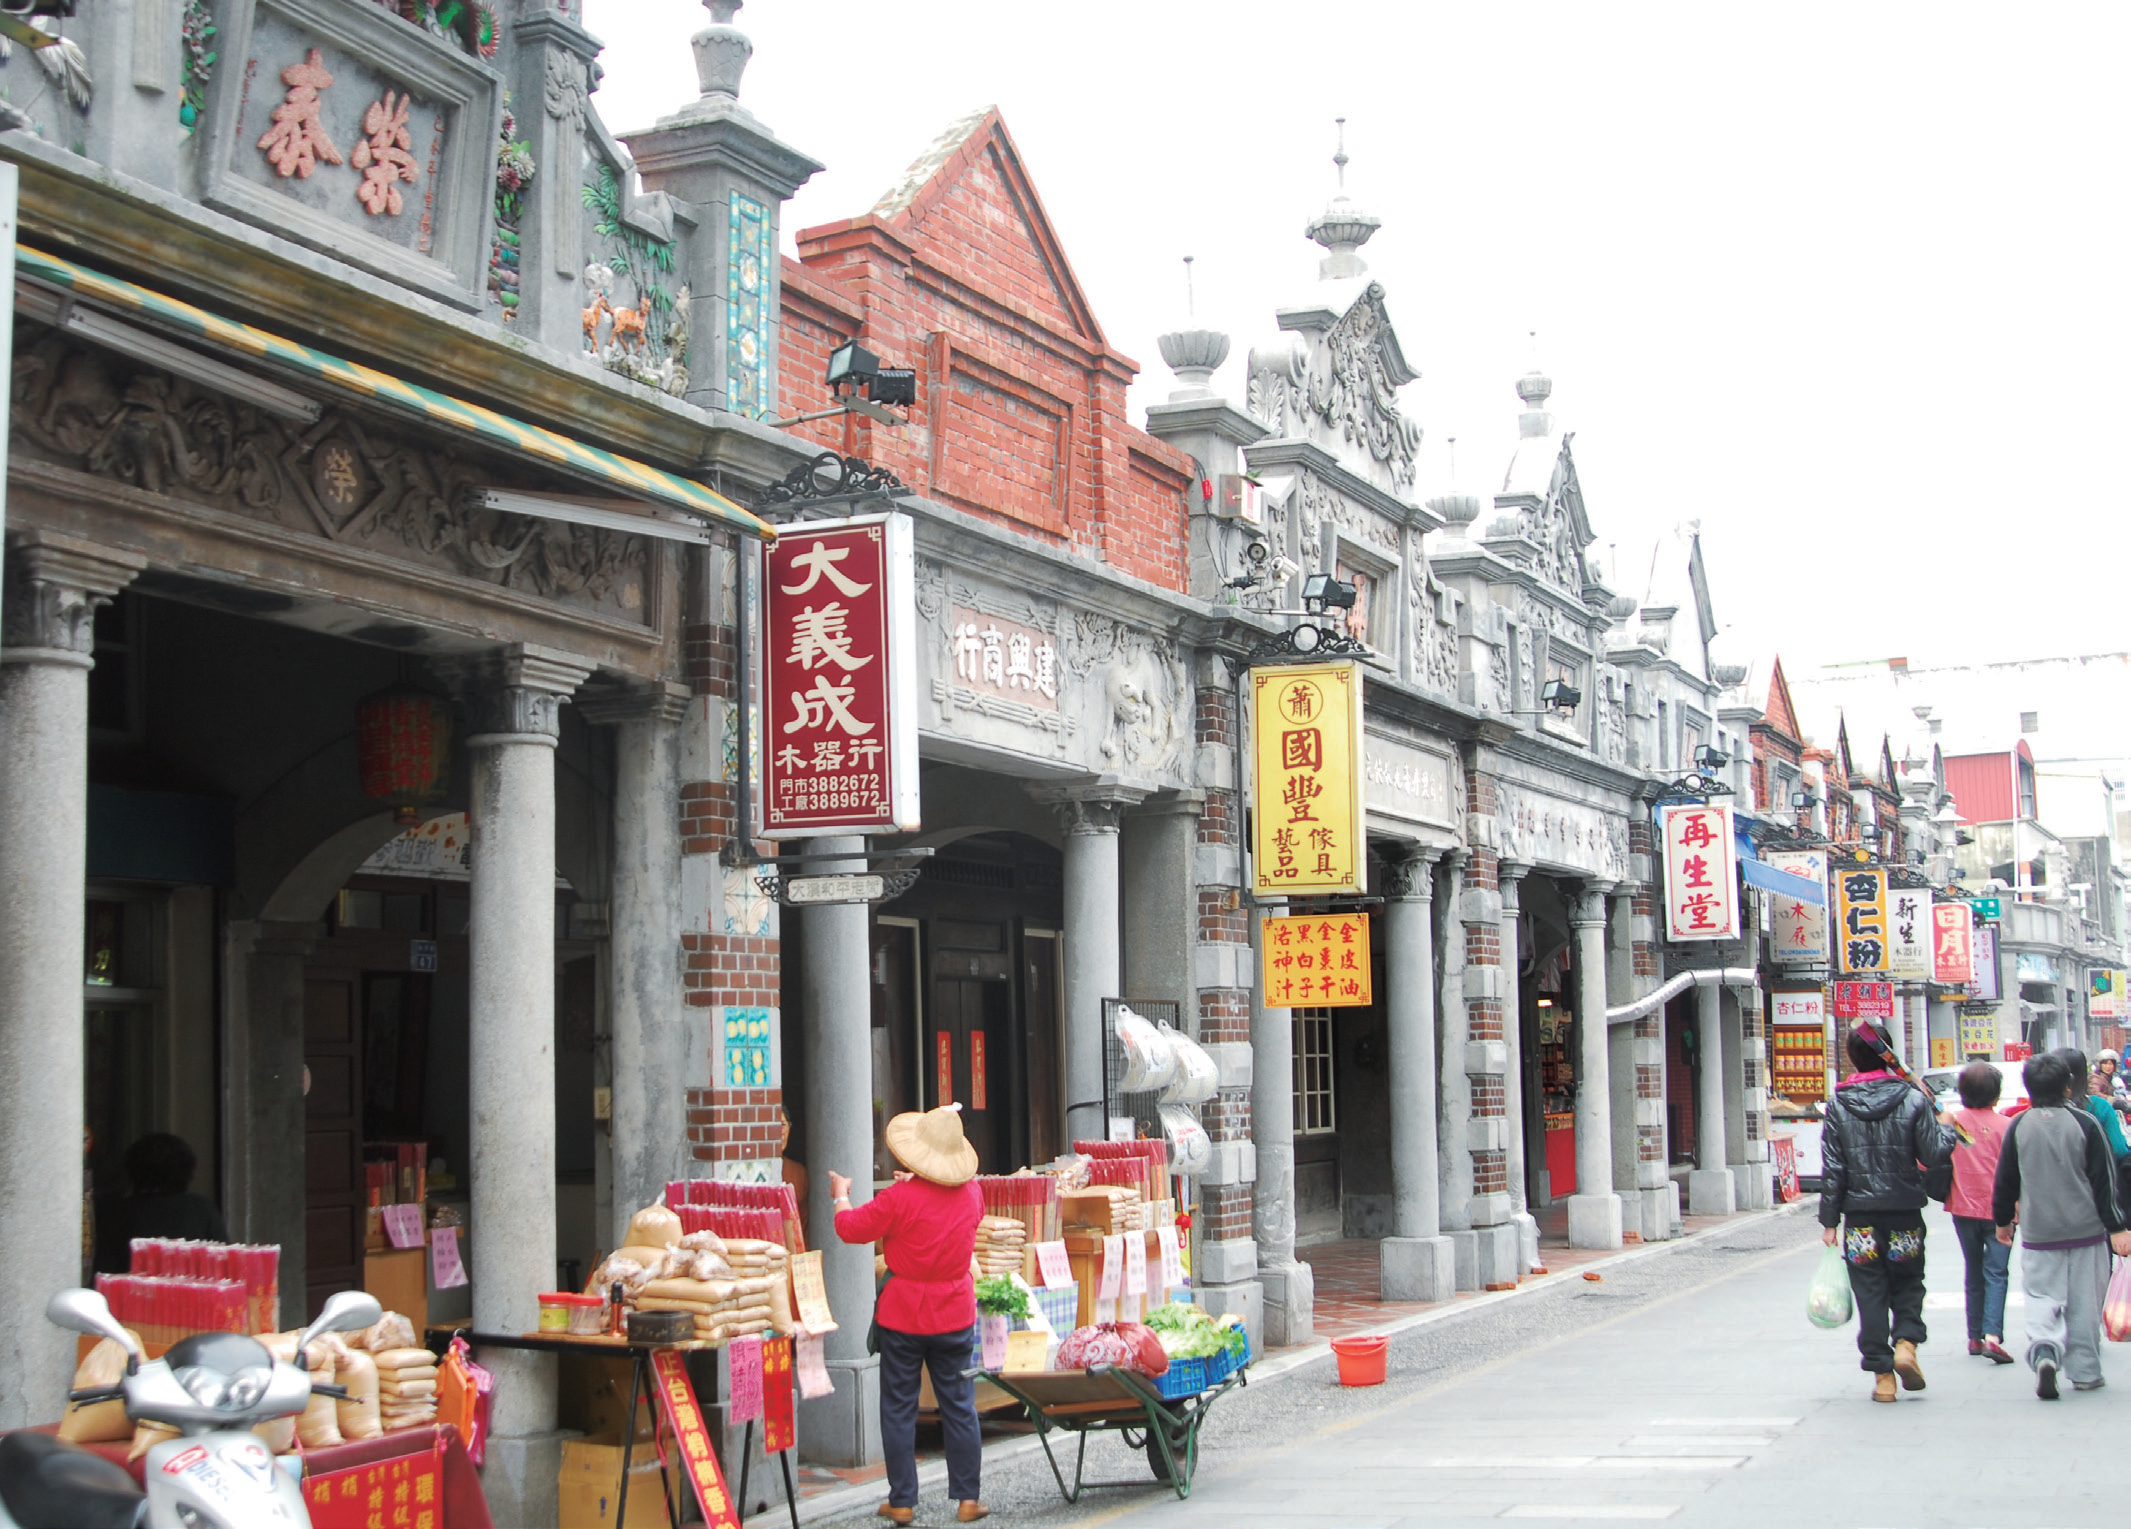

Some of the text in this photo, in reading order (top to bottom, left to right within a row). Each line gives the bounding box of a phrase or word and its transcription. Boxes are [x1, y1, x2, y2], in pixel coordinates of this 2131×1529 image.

[781, 541, 876, 736] 大義成
[1287, 684, 1315, 719] 蕭
[775, 738, 883, 775] 木器行
[1282, 727, 1324, 824] 國豐
[780, 773, 880, 795] 門市3882672
[780, 790, 880, 811] 工廠3889672
[1271, 827, 1301, 878] 藝品
[1308, 825, 1338, 878] 傢具
[1678, 813, 1721, 930] 再生堂
[1844, 873, 1882, 970] 杏仁粉
[1273, 924, 1294, 1000] 洛神汁
[1296, 923, 1314, 999] 黑白子
[1776, 1002, 1819, 1015] 杏仁粉
